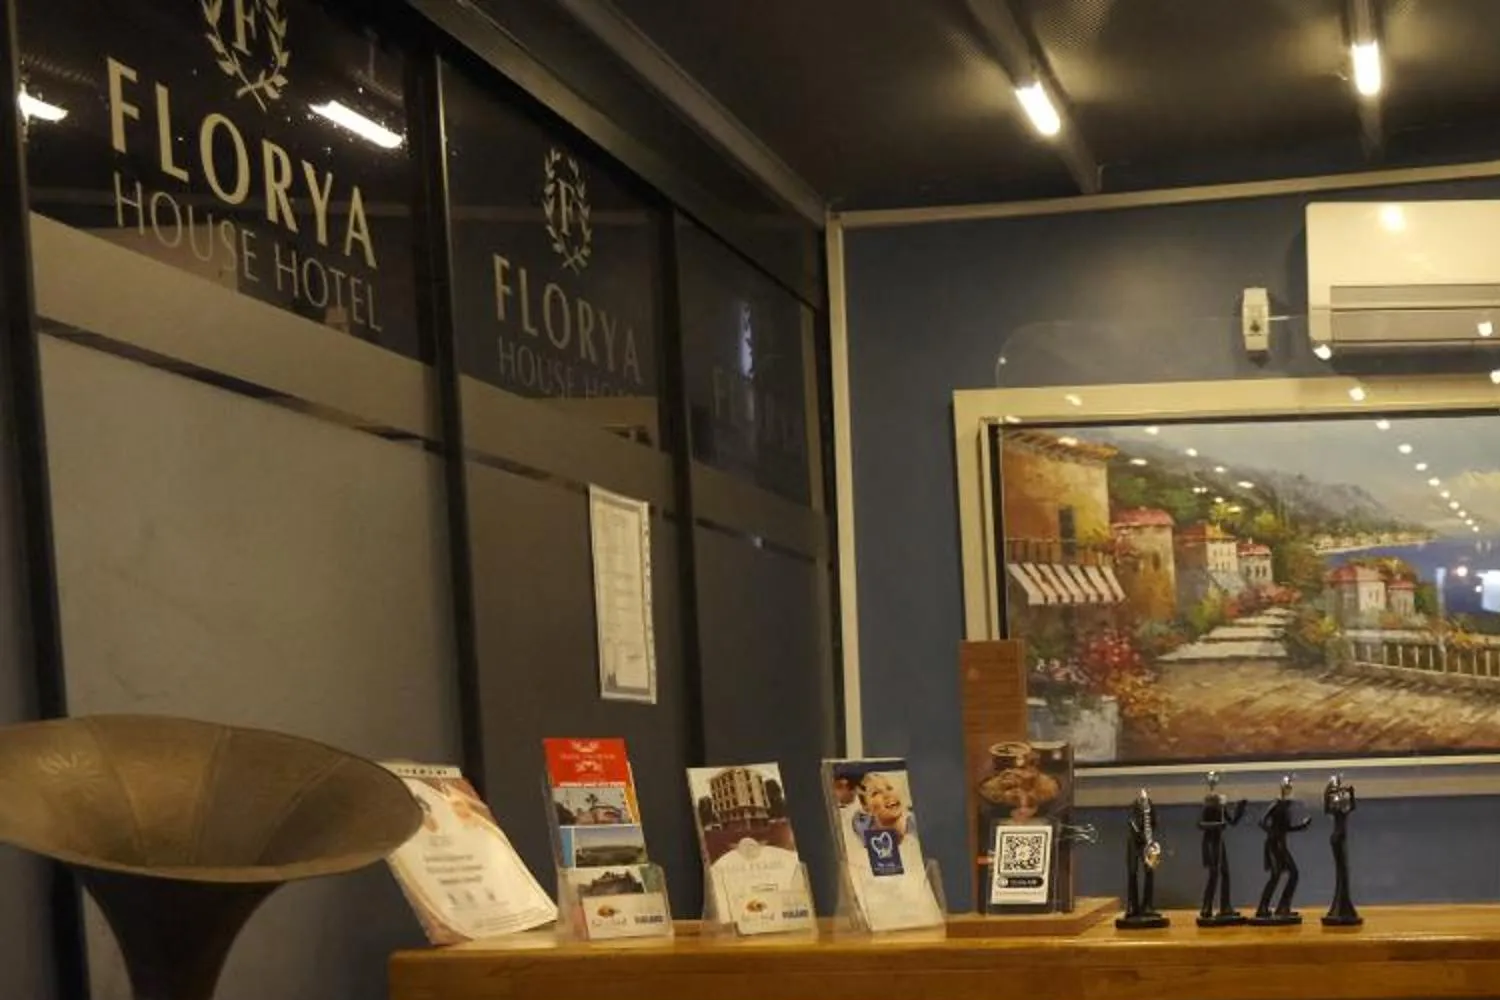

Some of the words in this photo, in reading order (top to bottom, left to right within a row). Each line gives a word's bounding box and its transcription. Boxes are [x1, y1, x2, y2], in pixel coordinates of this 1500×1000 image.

[107, 56, 377, 269] FLORYA
[114, 171, 260, 283] HOUSE
[275, 242, 383, 332] HOTEL
[493, 253, 642, 384] FLORYA
